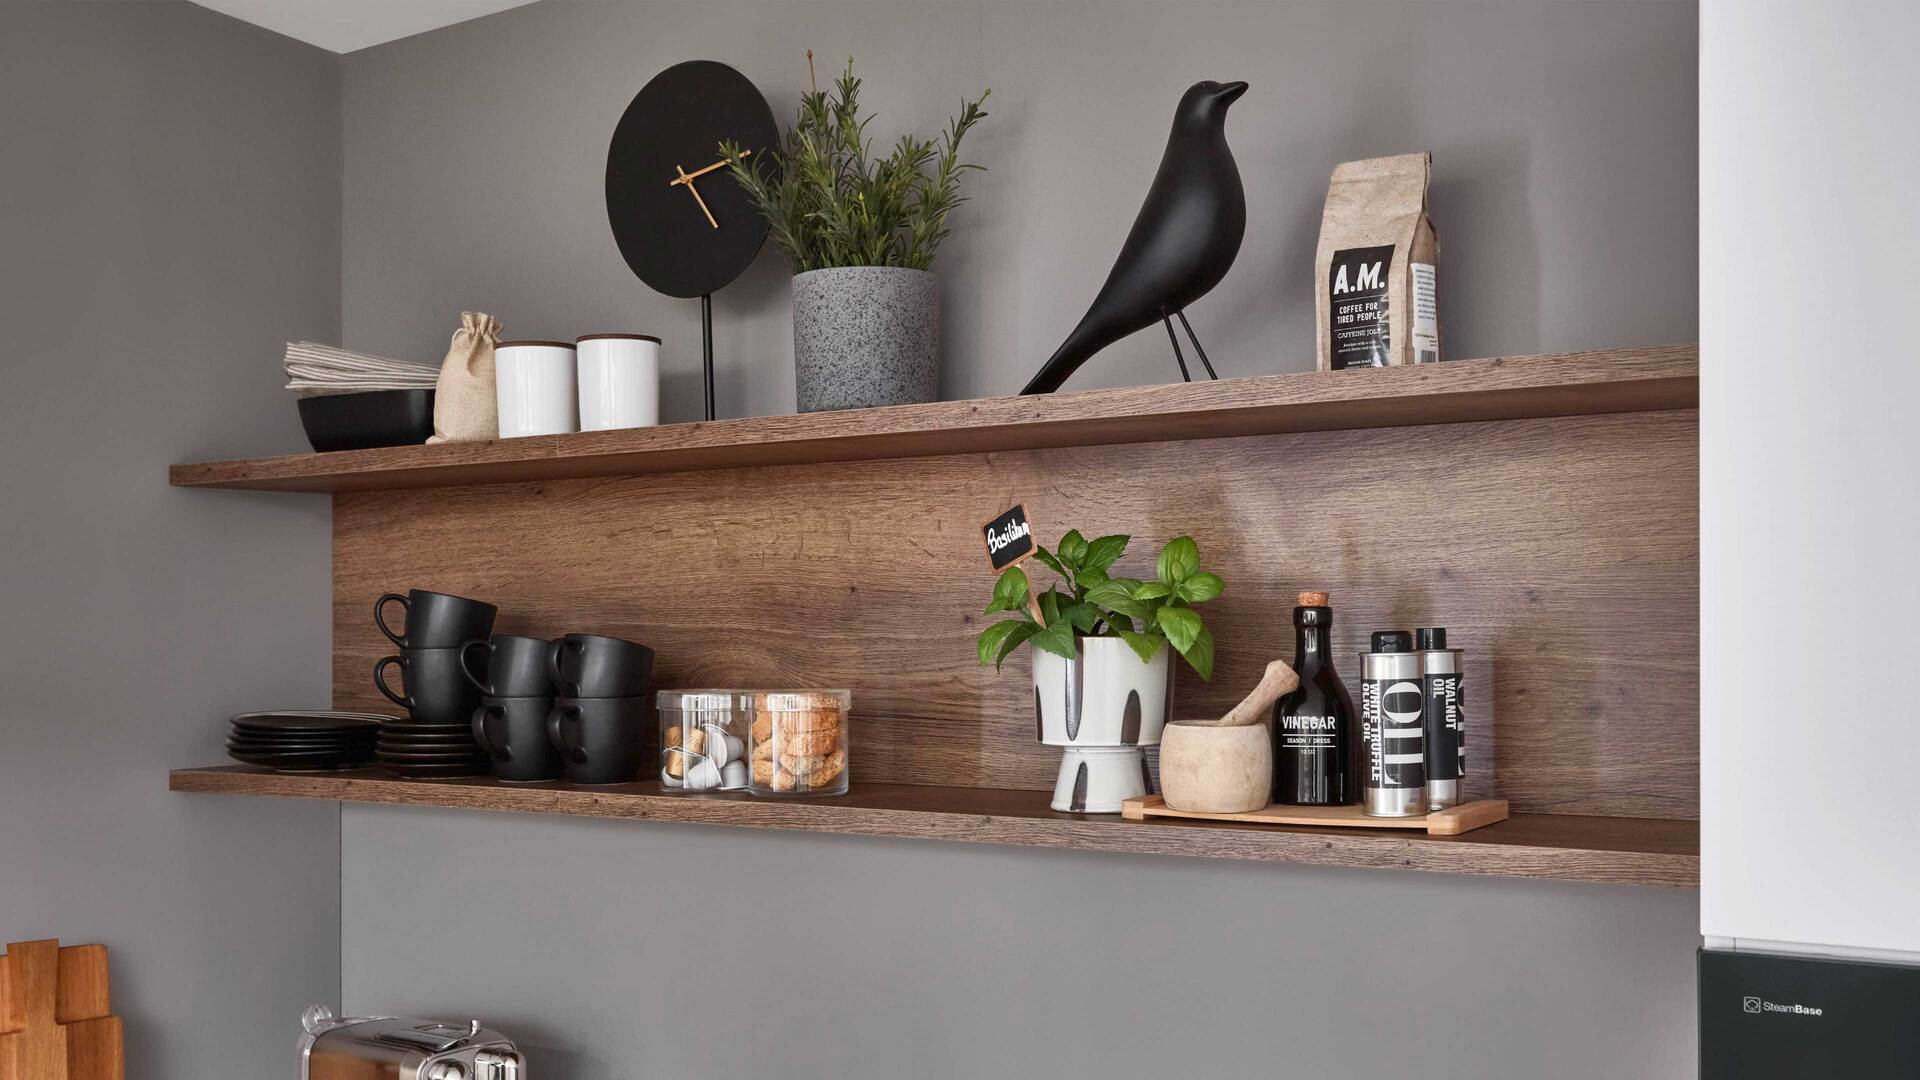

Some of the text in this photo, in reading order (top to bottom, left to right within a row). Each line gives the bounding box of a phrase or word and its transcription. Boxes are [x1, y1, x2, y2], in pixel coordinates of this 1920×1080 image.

[1333, 261, 1386, 295] A.M.
[1336, 311, 1382, 324] TIRED PEOPLE
[1339, 302, 1378, 314] COFFEE FOR
[1362, 683, 1371, 719] OLIVE
[1433, 678, 1445, 699] OIL
[1446, 678, 1457, 730] WALNUT
[1282, 715, 1336, 730] VINEGAR
[1370, 683, 1381, 781] WHITE TRUFFLE
[1382, 682, 1424, 784] OIL
[1763, 1001, 1823, 1016] SteamBase
